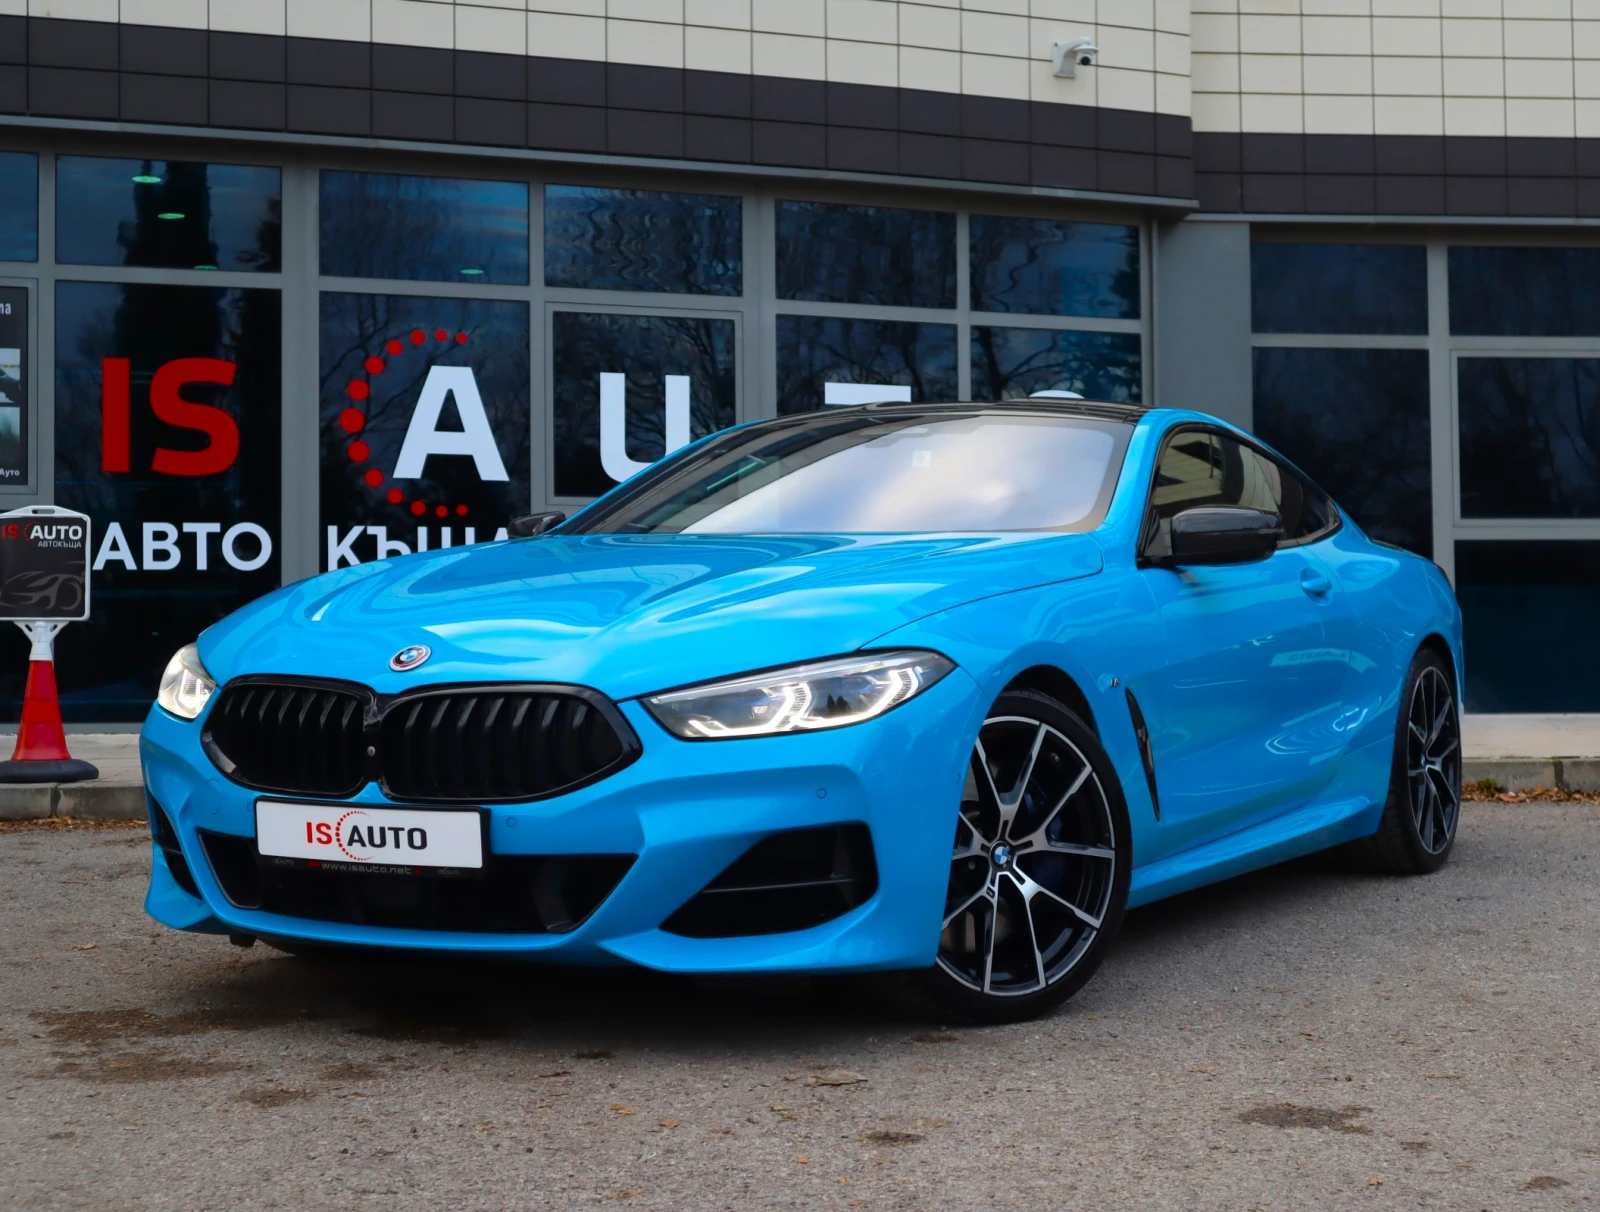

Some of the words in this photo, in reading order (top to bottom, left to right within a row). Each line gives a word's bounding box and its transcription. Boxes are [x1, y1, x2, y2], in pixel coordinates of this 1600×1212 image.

[101, 357, 240, 476] IS
[30, 525, 83, 540] AUTO
[37, 540, 82, 548] АВТОКЪЩА
[93, 522, 273, 571] АВТО
[306, 822, 333, 845] IS
[347, 825, 428, 850] AUTO
[321, 862, 412, 875] www.isauto.net
